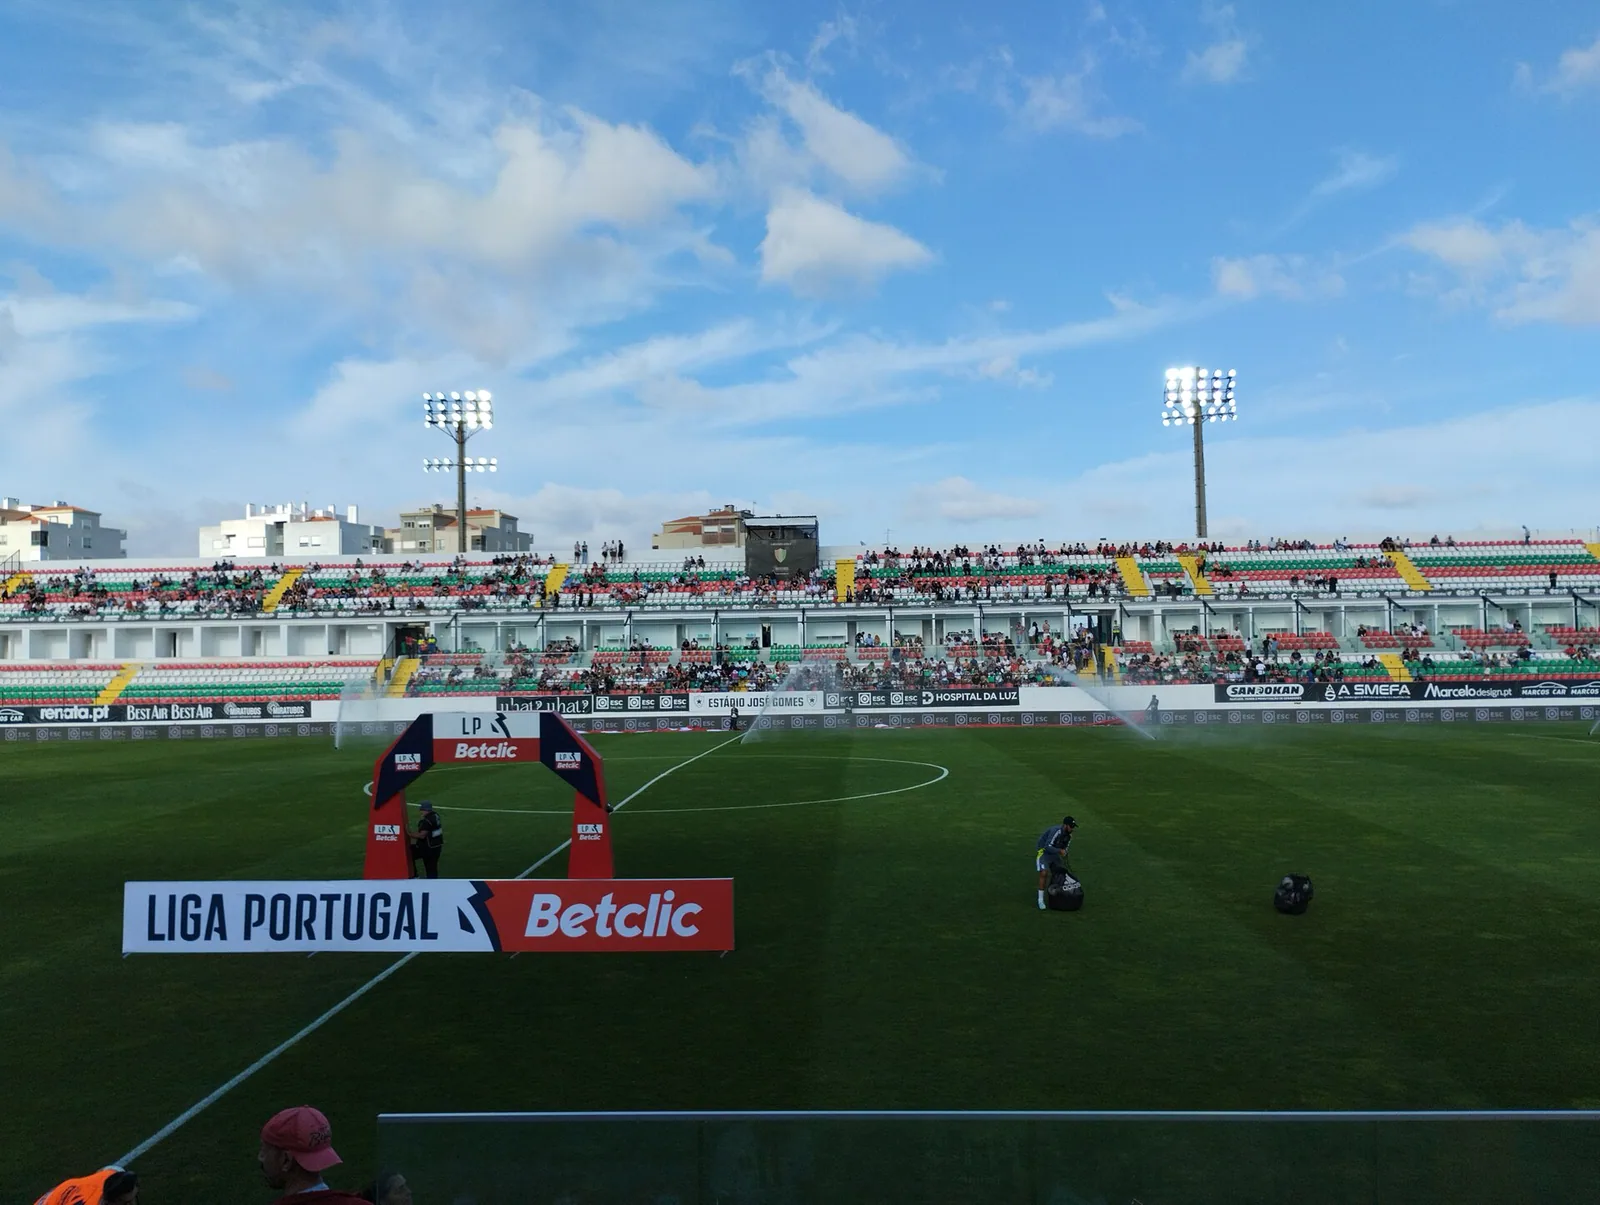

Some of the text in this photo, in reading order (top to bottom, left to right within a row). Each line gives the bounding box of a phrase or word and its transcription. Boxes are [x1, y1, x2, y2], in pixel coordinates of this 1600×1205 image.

[936, 691, 1017, 702] HOSPITAL DA LUZ
[1338, 684, 1411, 695] A SMEFA
[772, 697, 804, 707] GOMES
[40, 705, 110, 722] renata.pt
[462, 717, 481, 734] LP
[454, 741, 518, 759] Betclic
[557, 761, 579, 769] Betclic
[148, 892, 438, 942] LIGA PORTUGAL
[524, 889, 703, 938] Betclic
